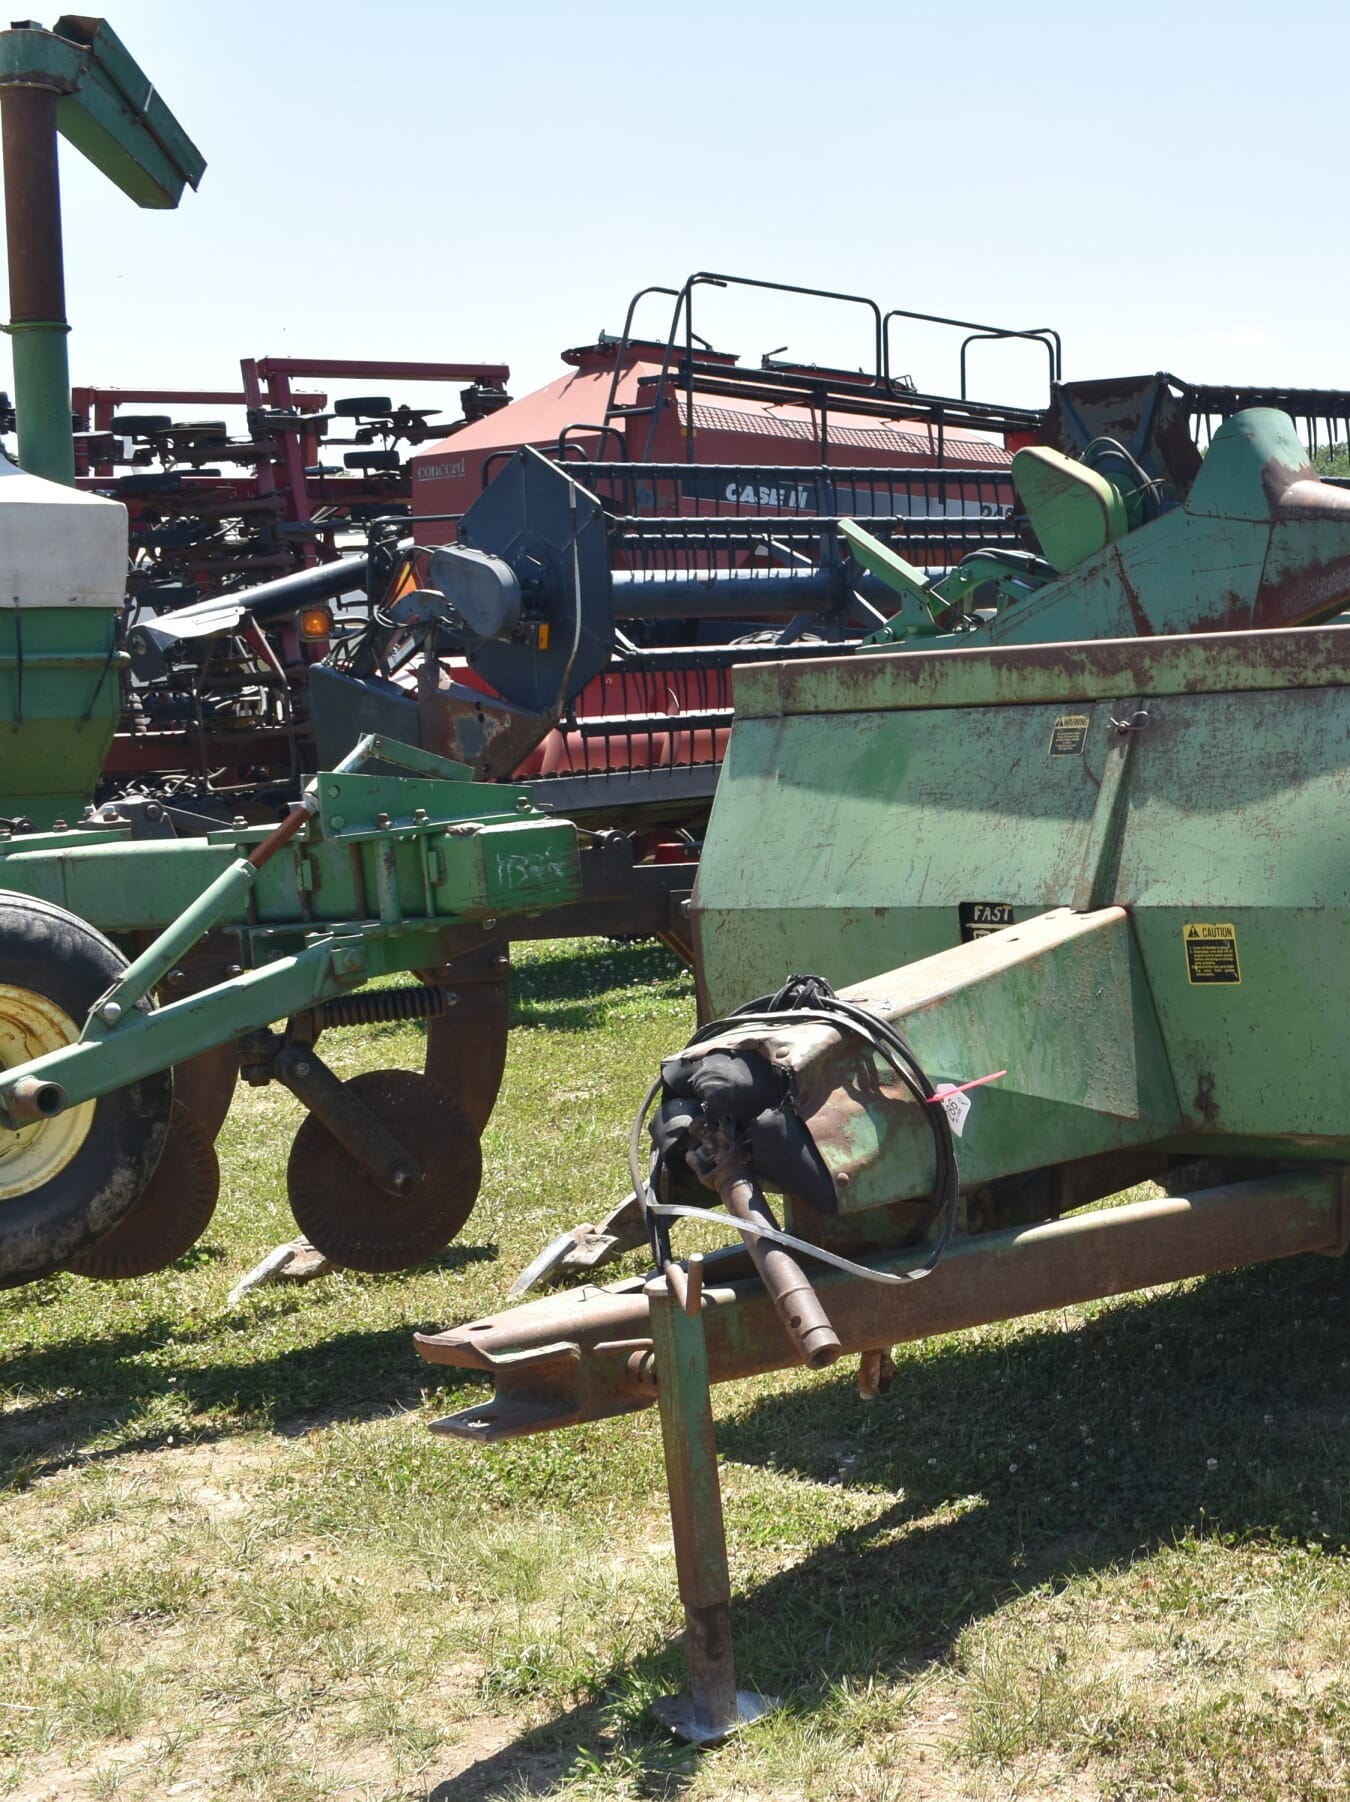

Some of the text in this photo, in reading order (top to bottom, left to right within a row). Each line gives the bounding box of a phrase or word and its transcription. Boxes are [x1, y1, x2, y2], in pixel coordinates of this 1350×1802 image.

[725, 483, 785, 506] CASE
[973, 904, 1013, 922] FAST
[1201, 927, 1233, 939] CAUTION
